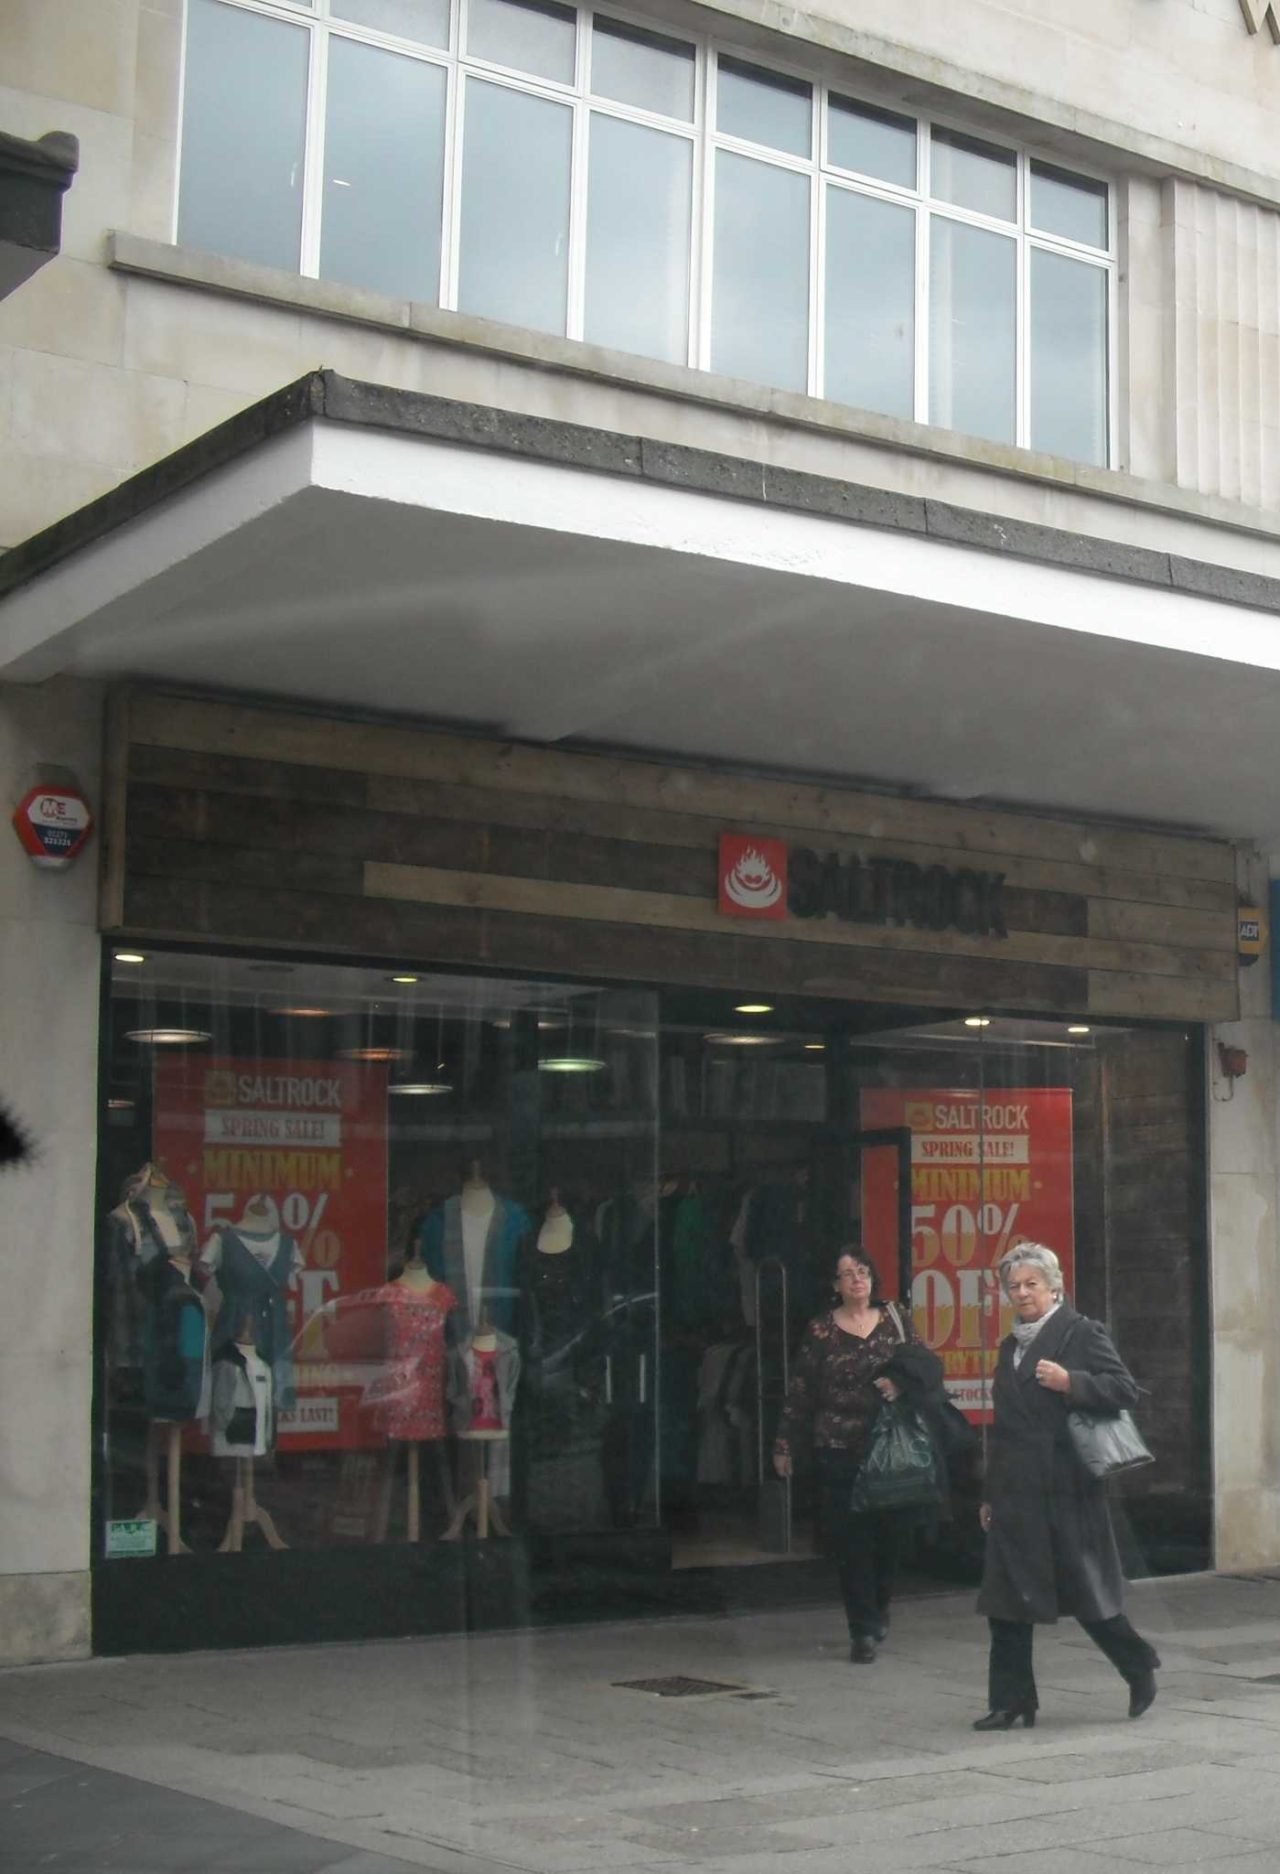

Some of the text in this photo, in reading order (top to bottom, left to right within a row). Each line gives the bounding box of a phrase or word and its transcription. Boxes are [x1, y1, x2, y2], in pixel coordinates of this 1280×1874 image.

[1240, 924, 1259, 937] ADT
[238, 1075, 342, 1107] SALTROCK
[220, 1117, 325, 1140] SPRING SALE!
[935, 1104, 1029, 1129] SALTROCK
[921, 1141, 973, 1158] SPRING
[203, 1151, 342, 1191] MINIMUM
[911, 1203, 1029, 1267] 50%
